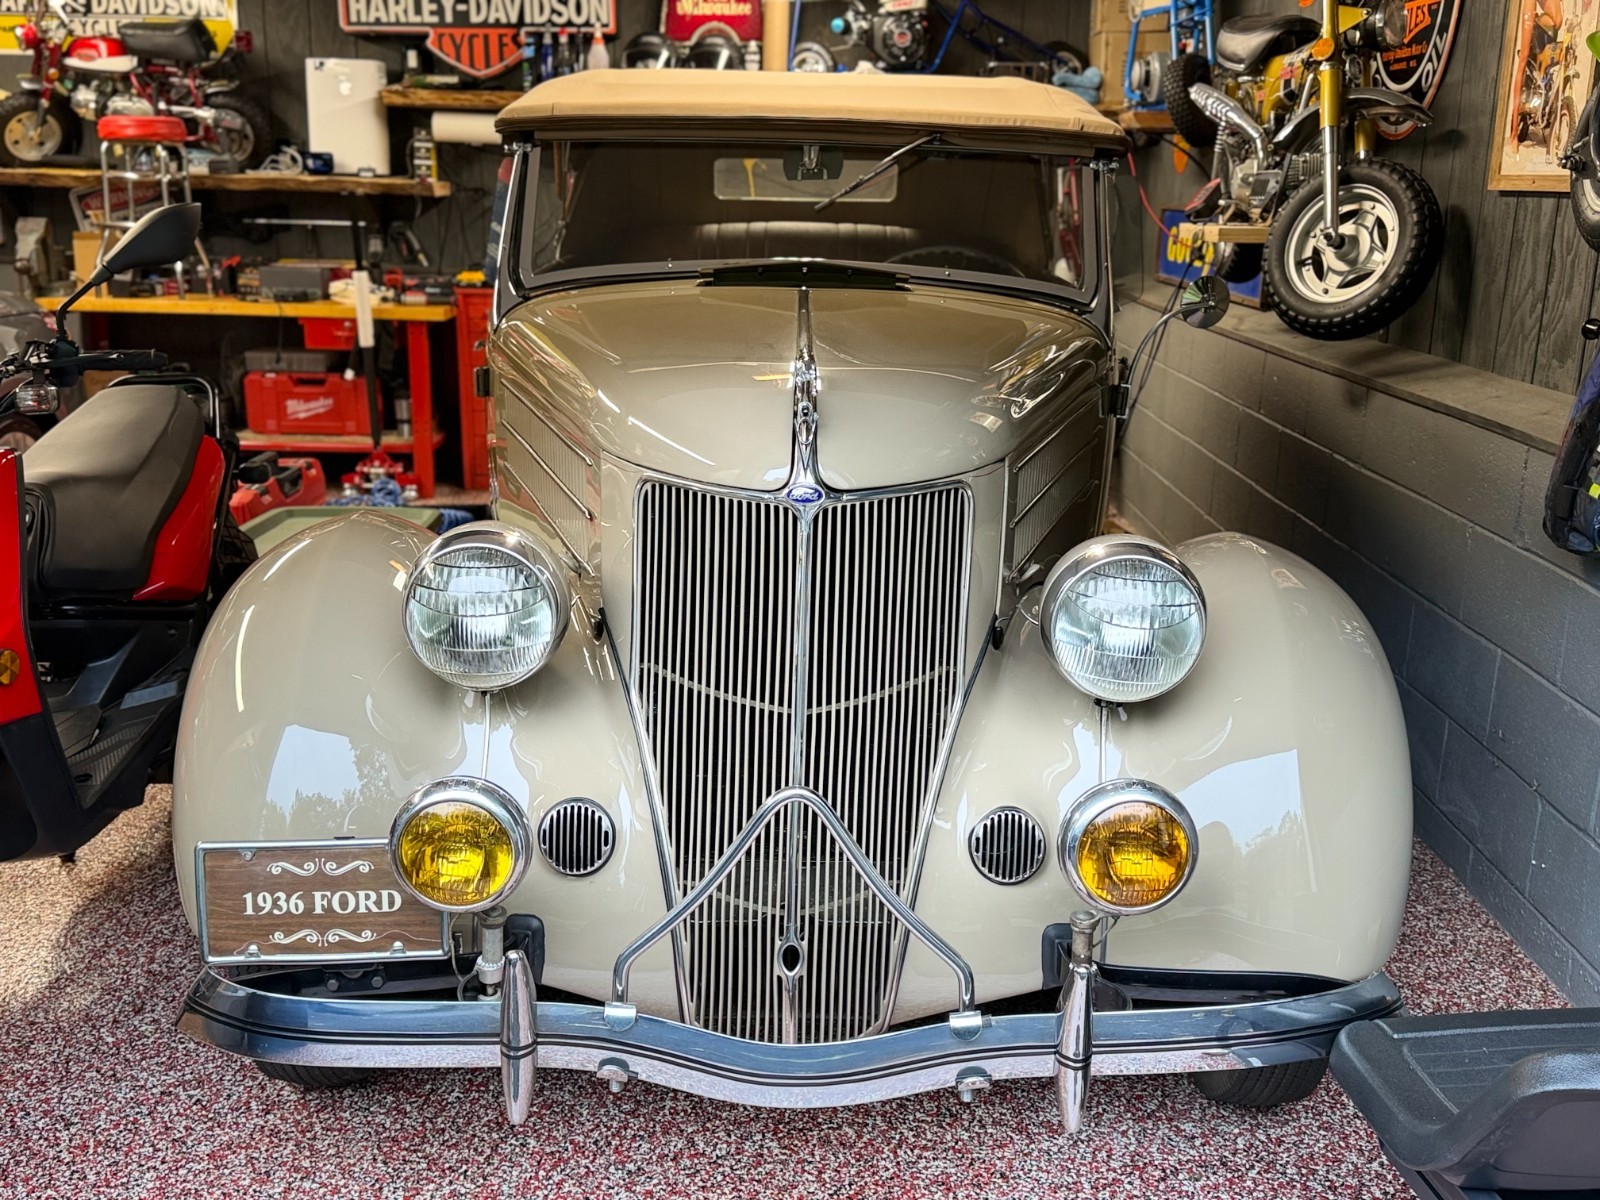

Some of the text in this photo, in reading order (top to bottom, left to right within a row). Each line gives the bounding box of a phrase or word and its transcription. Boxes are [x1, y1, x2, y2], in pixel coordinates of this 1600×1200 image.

[350, 0, 609, 25] HARLEY-DAVIDSON
[437, 31, 525, 70] CYCLES
[242, 889, 403, 916] 1936 FORD
